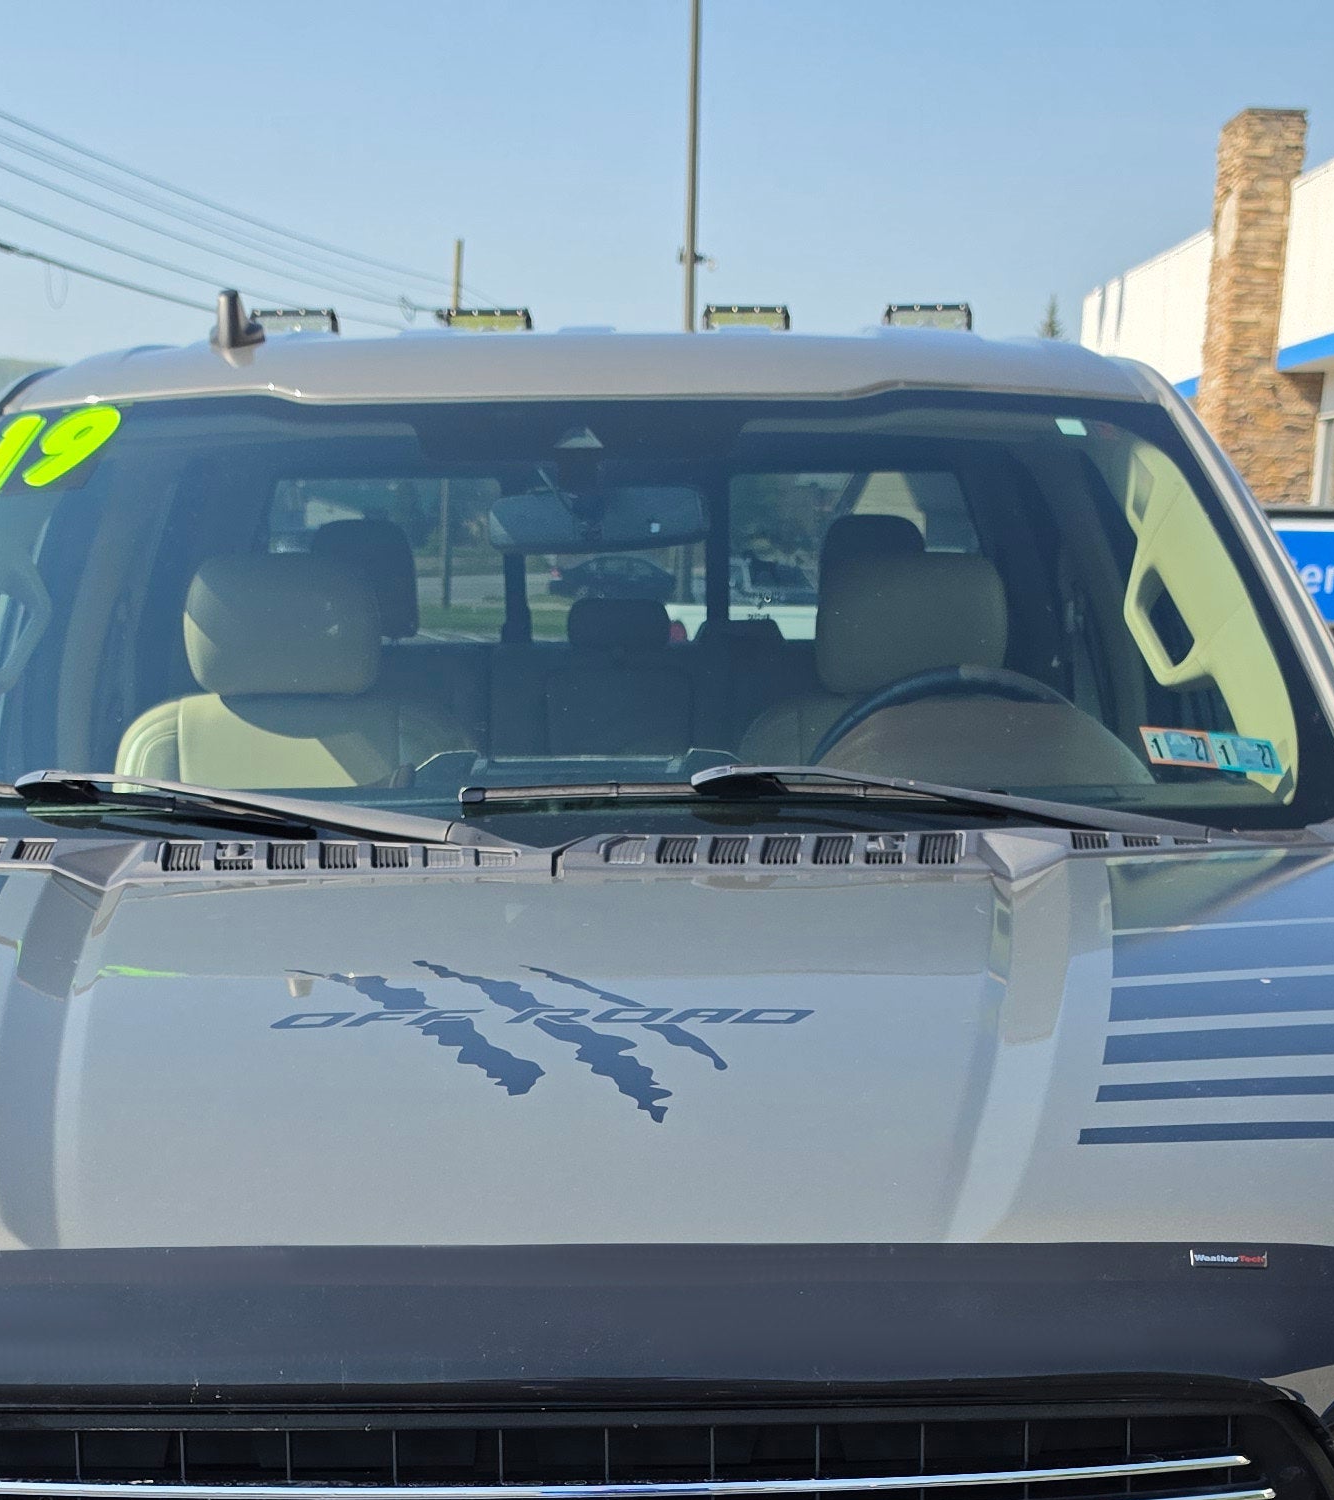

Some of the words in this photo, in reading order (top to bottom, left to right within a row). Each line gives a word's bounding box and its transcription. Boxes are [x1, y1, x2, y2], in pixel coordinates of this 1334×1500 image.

[269, 1009, 485, 1029] OFF
[505, 1007, 815, 1025] ROAD
[1193, 1254, 1265, 1263] WeatherTech
